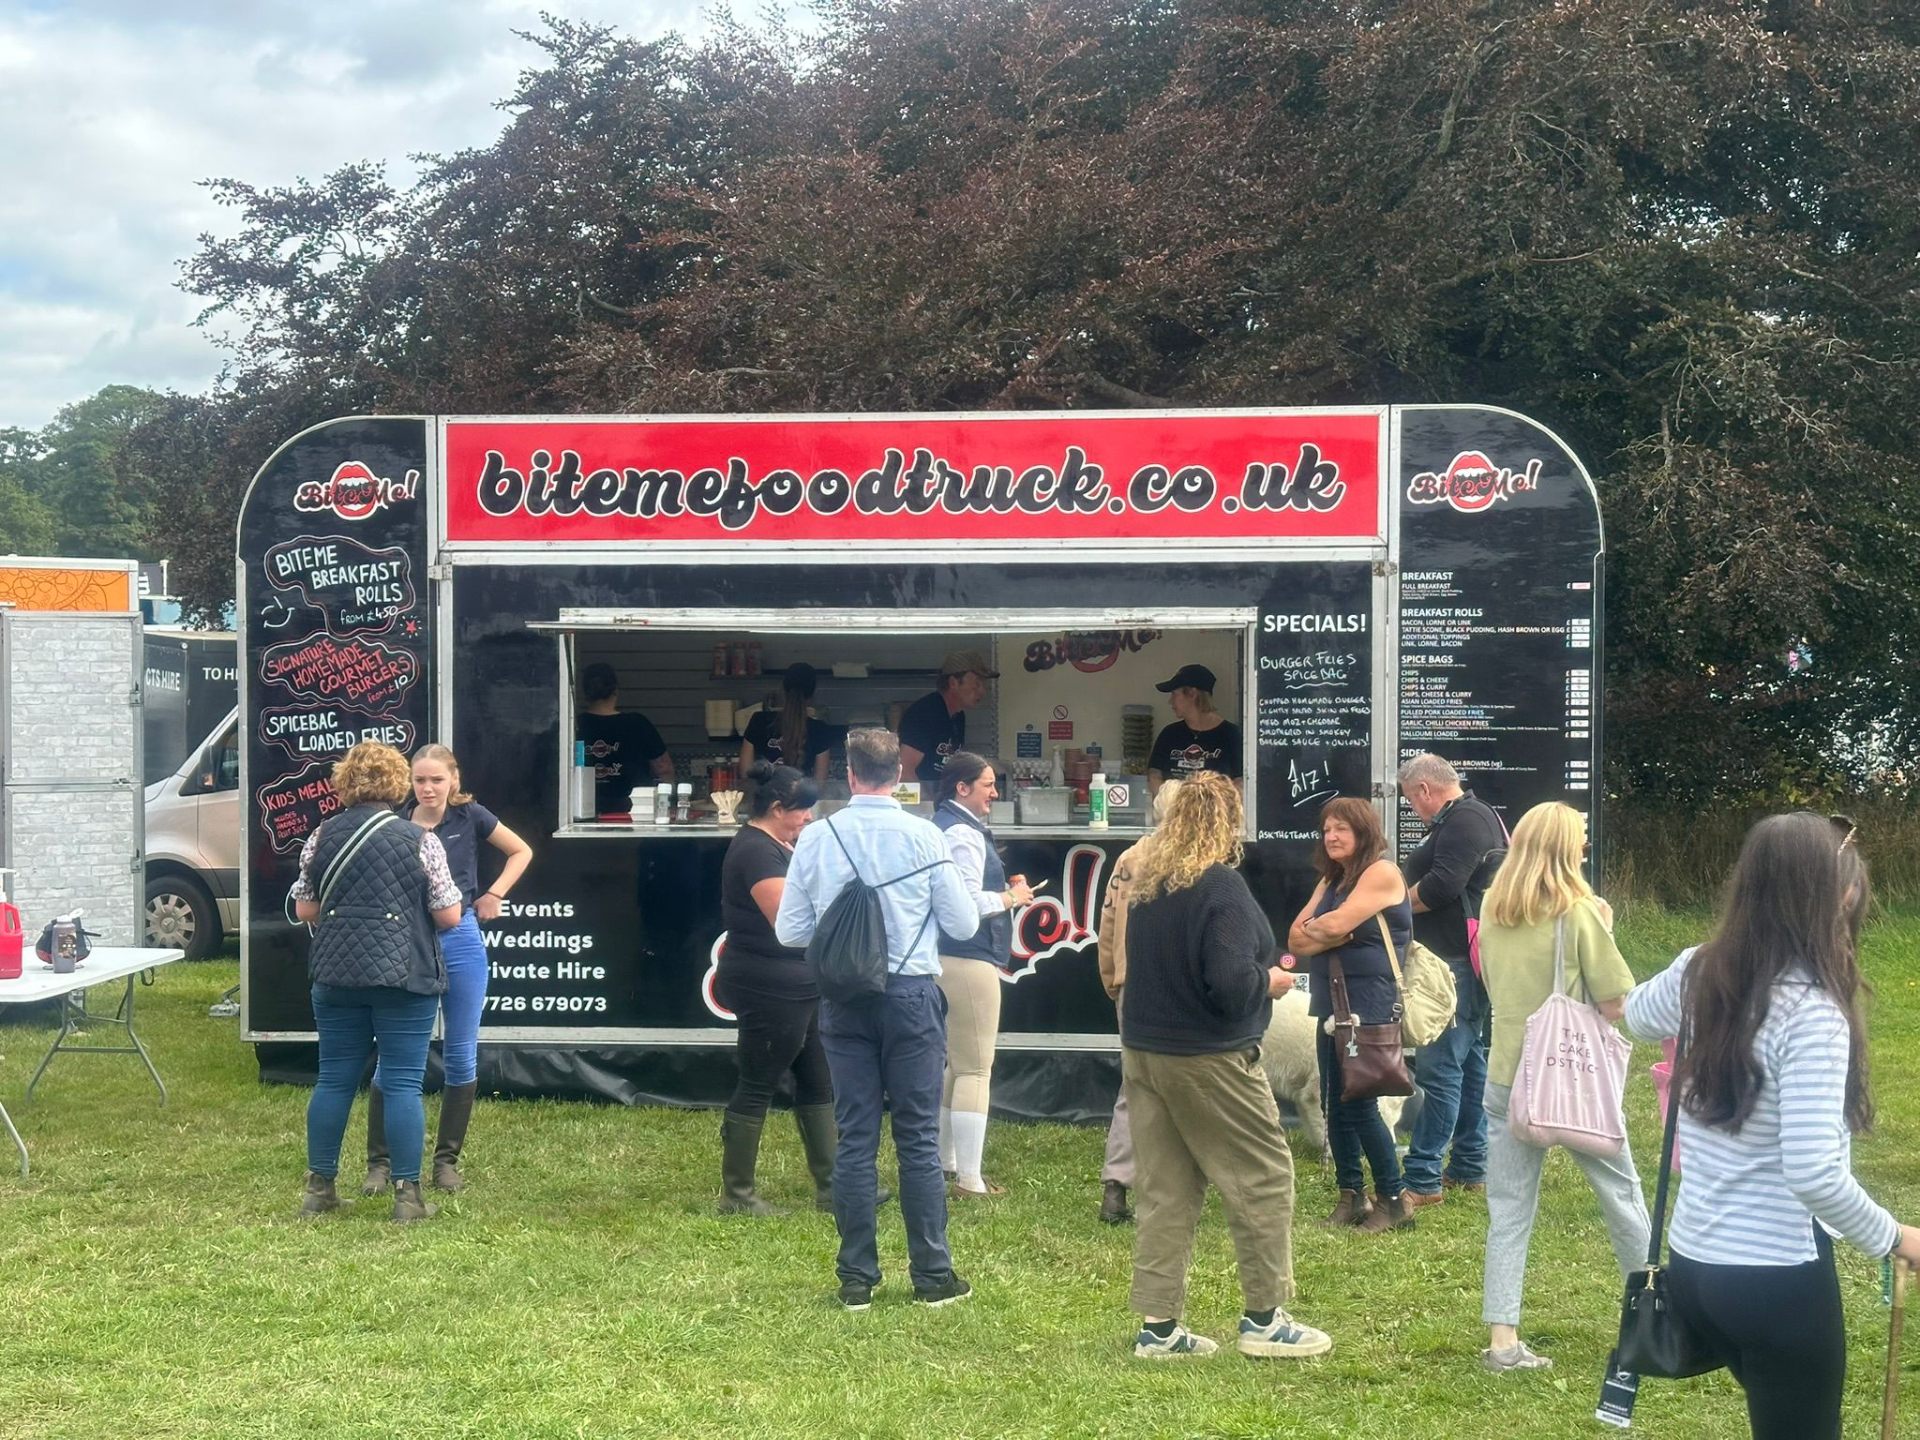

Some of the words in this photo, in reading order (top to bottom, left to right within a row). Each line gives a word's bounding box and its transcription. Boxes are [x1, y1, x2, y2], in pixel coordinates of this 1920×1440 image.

[477, 443, 1347, 530] bitemefoodtruck.co.uk
[275, 545, 338, 576] BITEME
[311, 562, 400, 589] BREAKFAST
[1402, 572, 1453, 580] BREAKFAST
[356, 583, 402, 606] ROLLS
[1402, 608, 1452, 616] BREAKFAST
[1455, 608, 1483, 616] ROLLS
[1264, 614, 1366, 632] SPECIALS!
[267, 638, 336, 677] SIGNATURE
[292, 641, 367, 689] HOMEMADE
[1260, 656, 1313, 669] BURGER
[1315, 651, 1356, 665] FRIES
[1401, 655, 1426, 664] SPICE
[1428, 655, 1453, 664] BAGS
[203, 667, 221, 680] TO
[319, 649, 383, 693] GOURMET
[347, 656, 411, 700] BURGERS
[1284, 670, 1318, 681] SPICE
[161, 671, 180, 691] HIRE
[299, 730, 355, 751] LOADED
[266, 791, 296, 810] KIDS
[498, 900, 574, 917] Events
[481, 931, 593, 954] Weddings
[557, 961, 606, 979] Hire
[532, 996, 607, 1011] 679073
[1562, 1027, 1587, 1043] THE
[1559, 1042, 1591, 1059] CAKE
